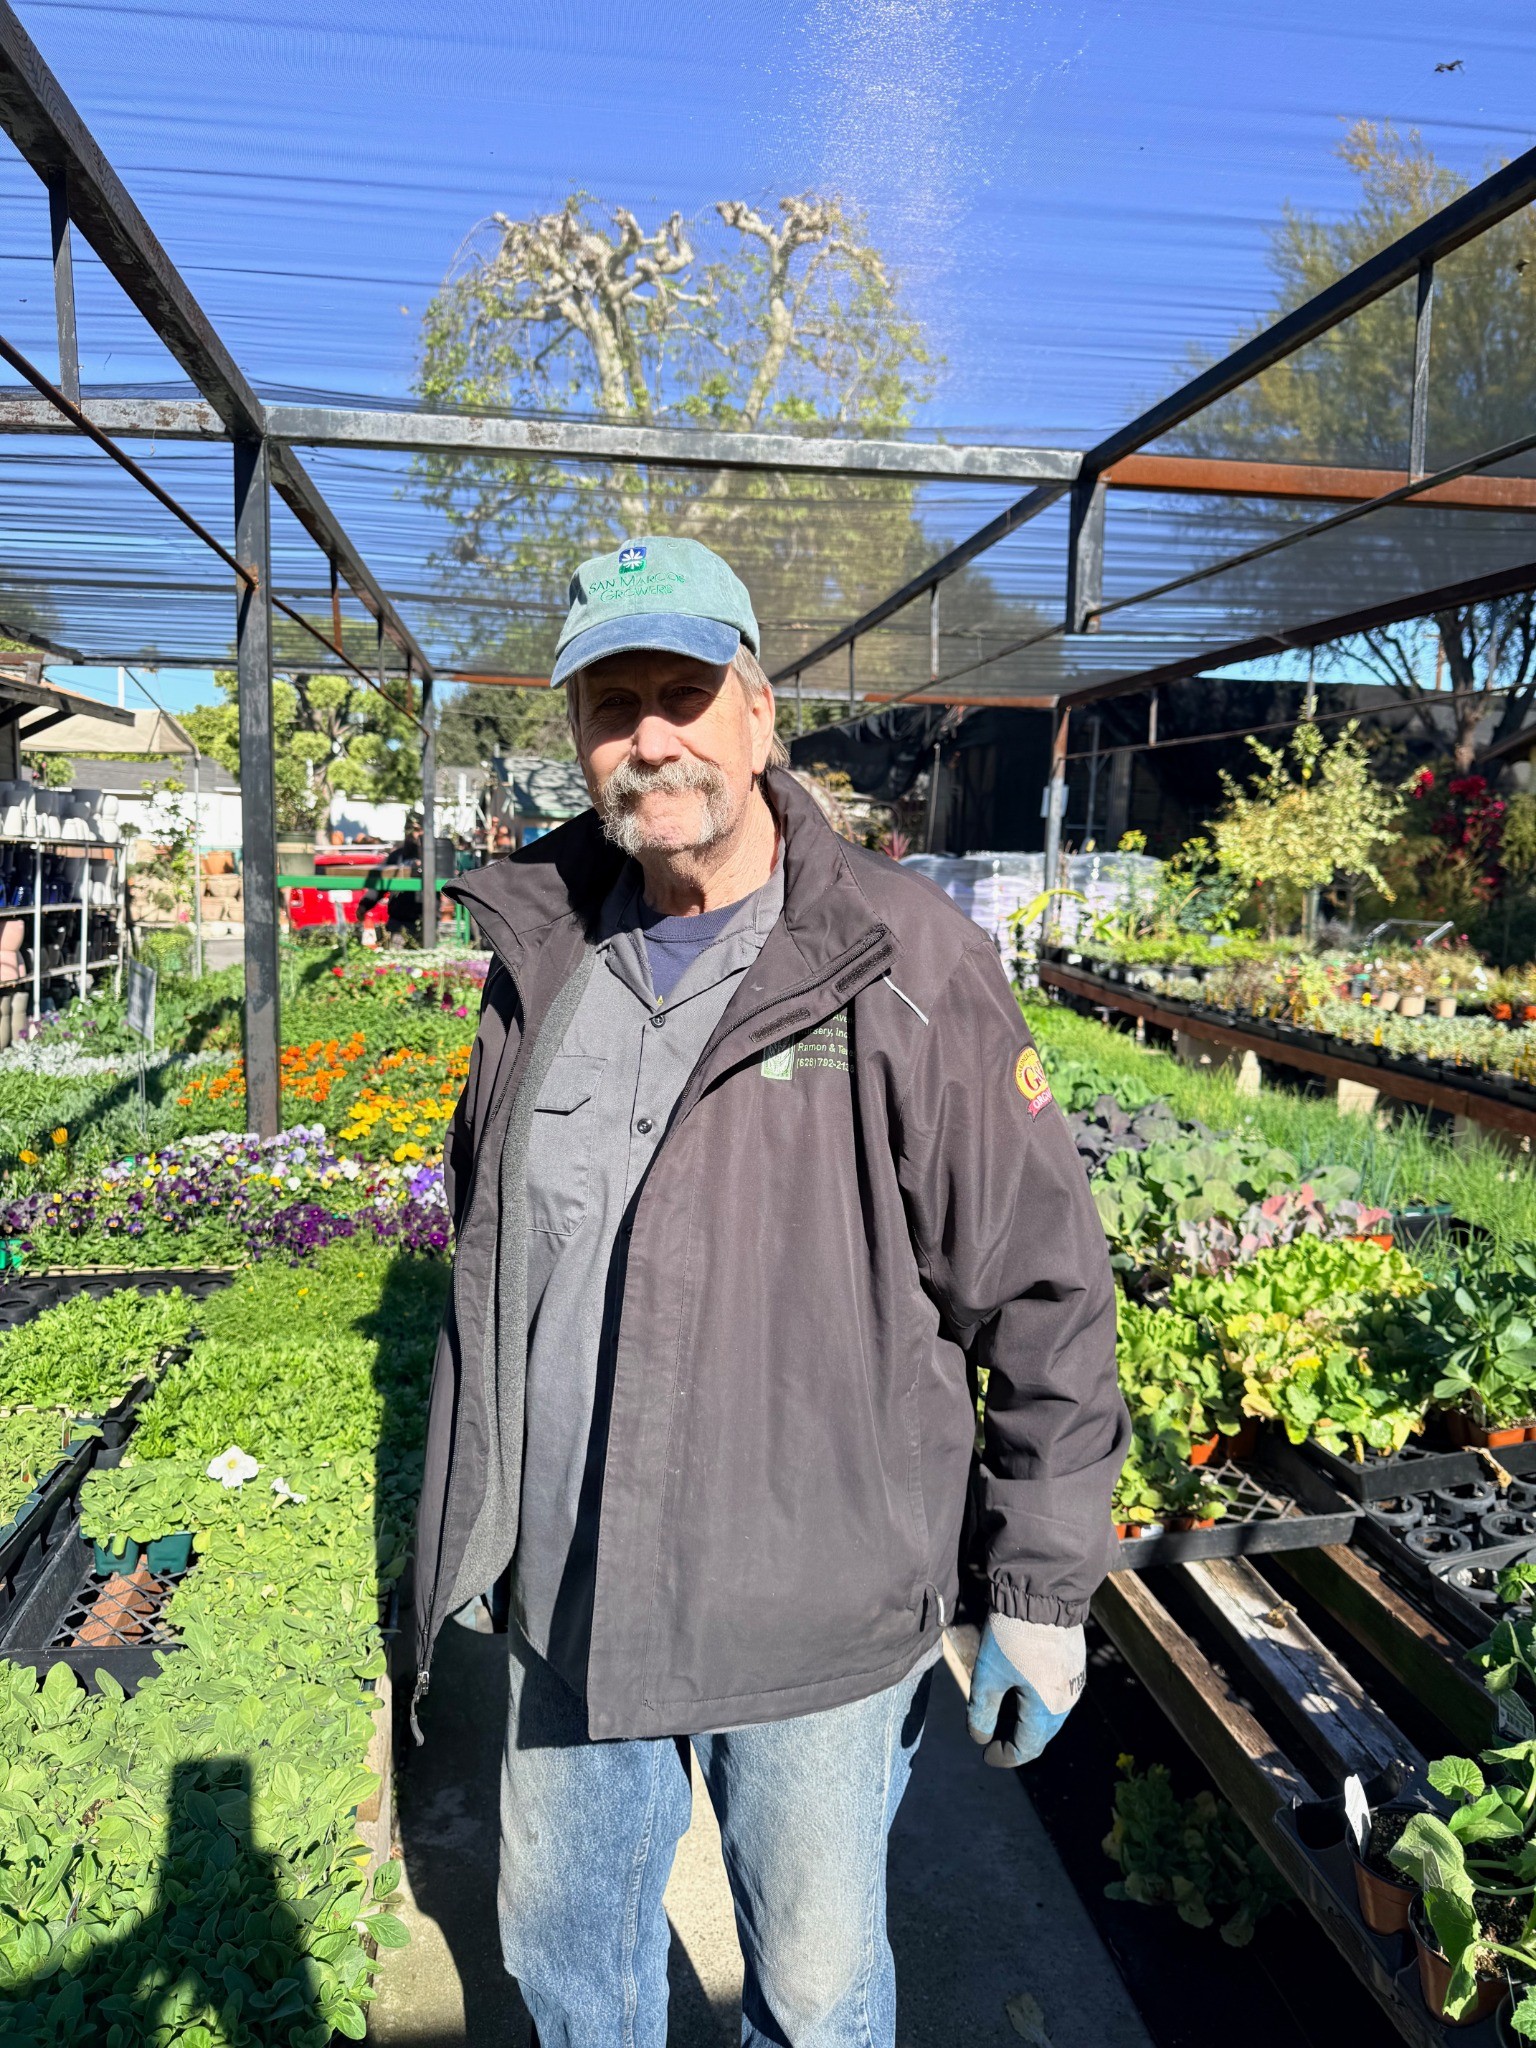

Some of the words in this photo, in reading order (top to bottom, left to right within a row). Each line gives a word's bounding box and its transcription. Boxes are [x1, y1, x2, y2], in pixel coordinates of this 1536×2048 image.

[588, 578, 616, 595] SAN
[620, 571, 685, 587] MARCOS
[600, 584, 674, 602] GROWERS
[797, 1042, 827, 1052] Ramon
[829, 1043, 836, 1053] &
